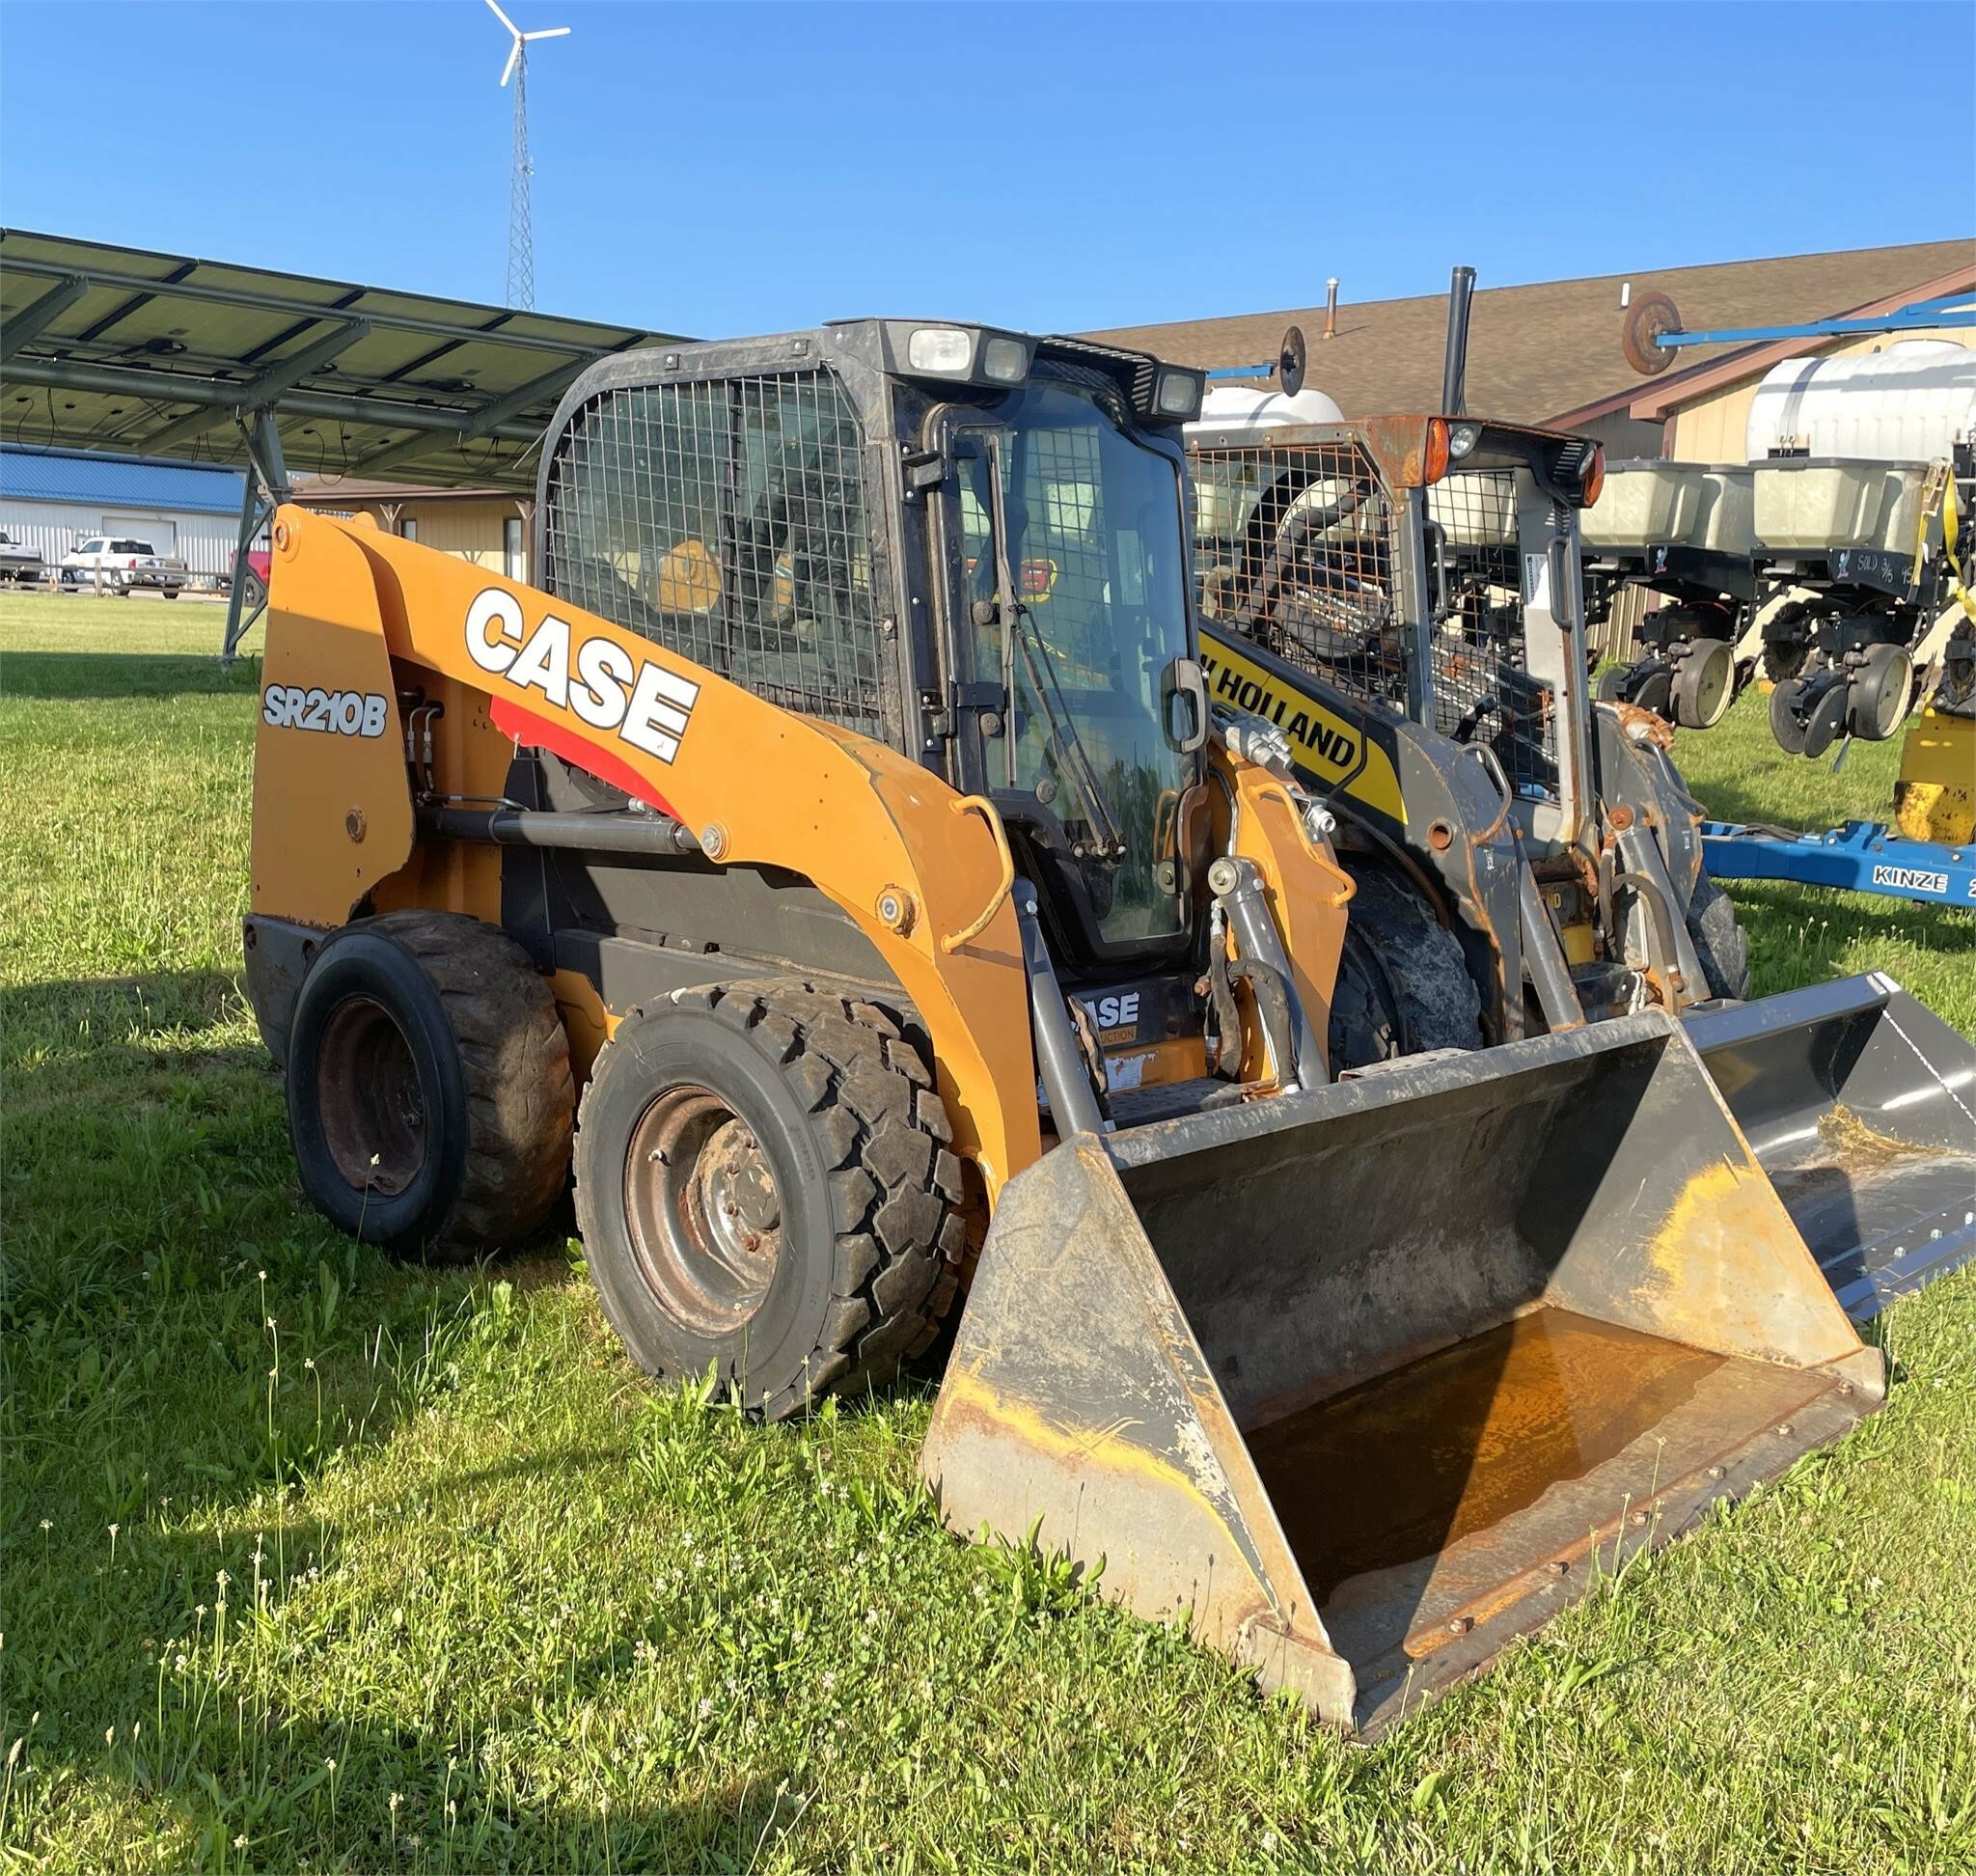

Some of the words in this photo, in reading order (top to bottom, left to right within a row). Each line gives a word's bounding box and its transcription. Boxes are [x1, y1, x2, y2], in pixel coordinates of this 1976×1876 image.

[1858, 555, 1878, 571] SOLD
[464, 587, 702, 765] CASE
[262, 683, 388, 738] SR210B
[1217, 668, 1356, 768] HOLLAND
[1874, 865, 1948, 893] KINZE
